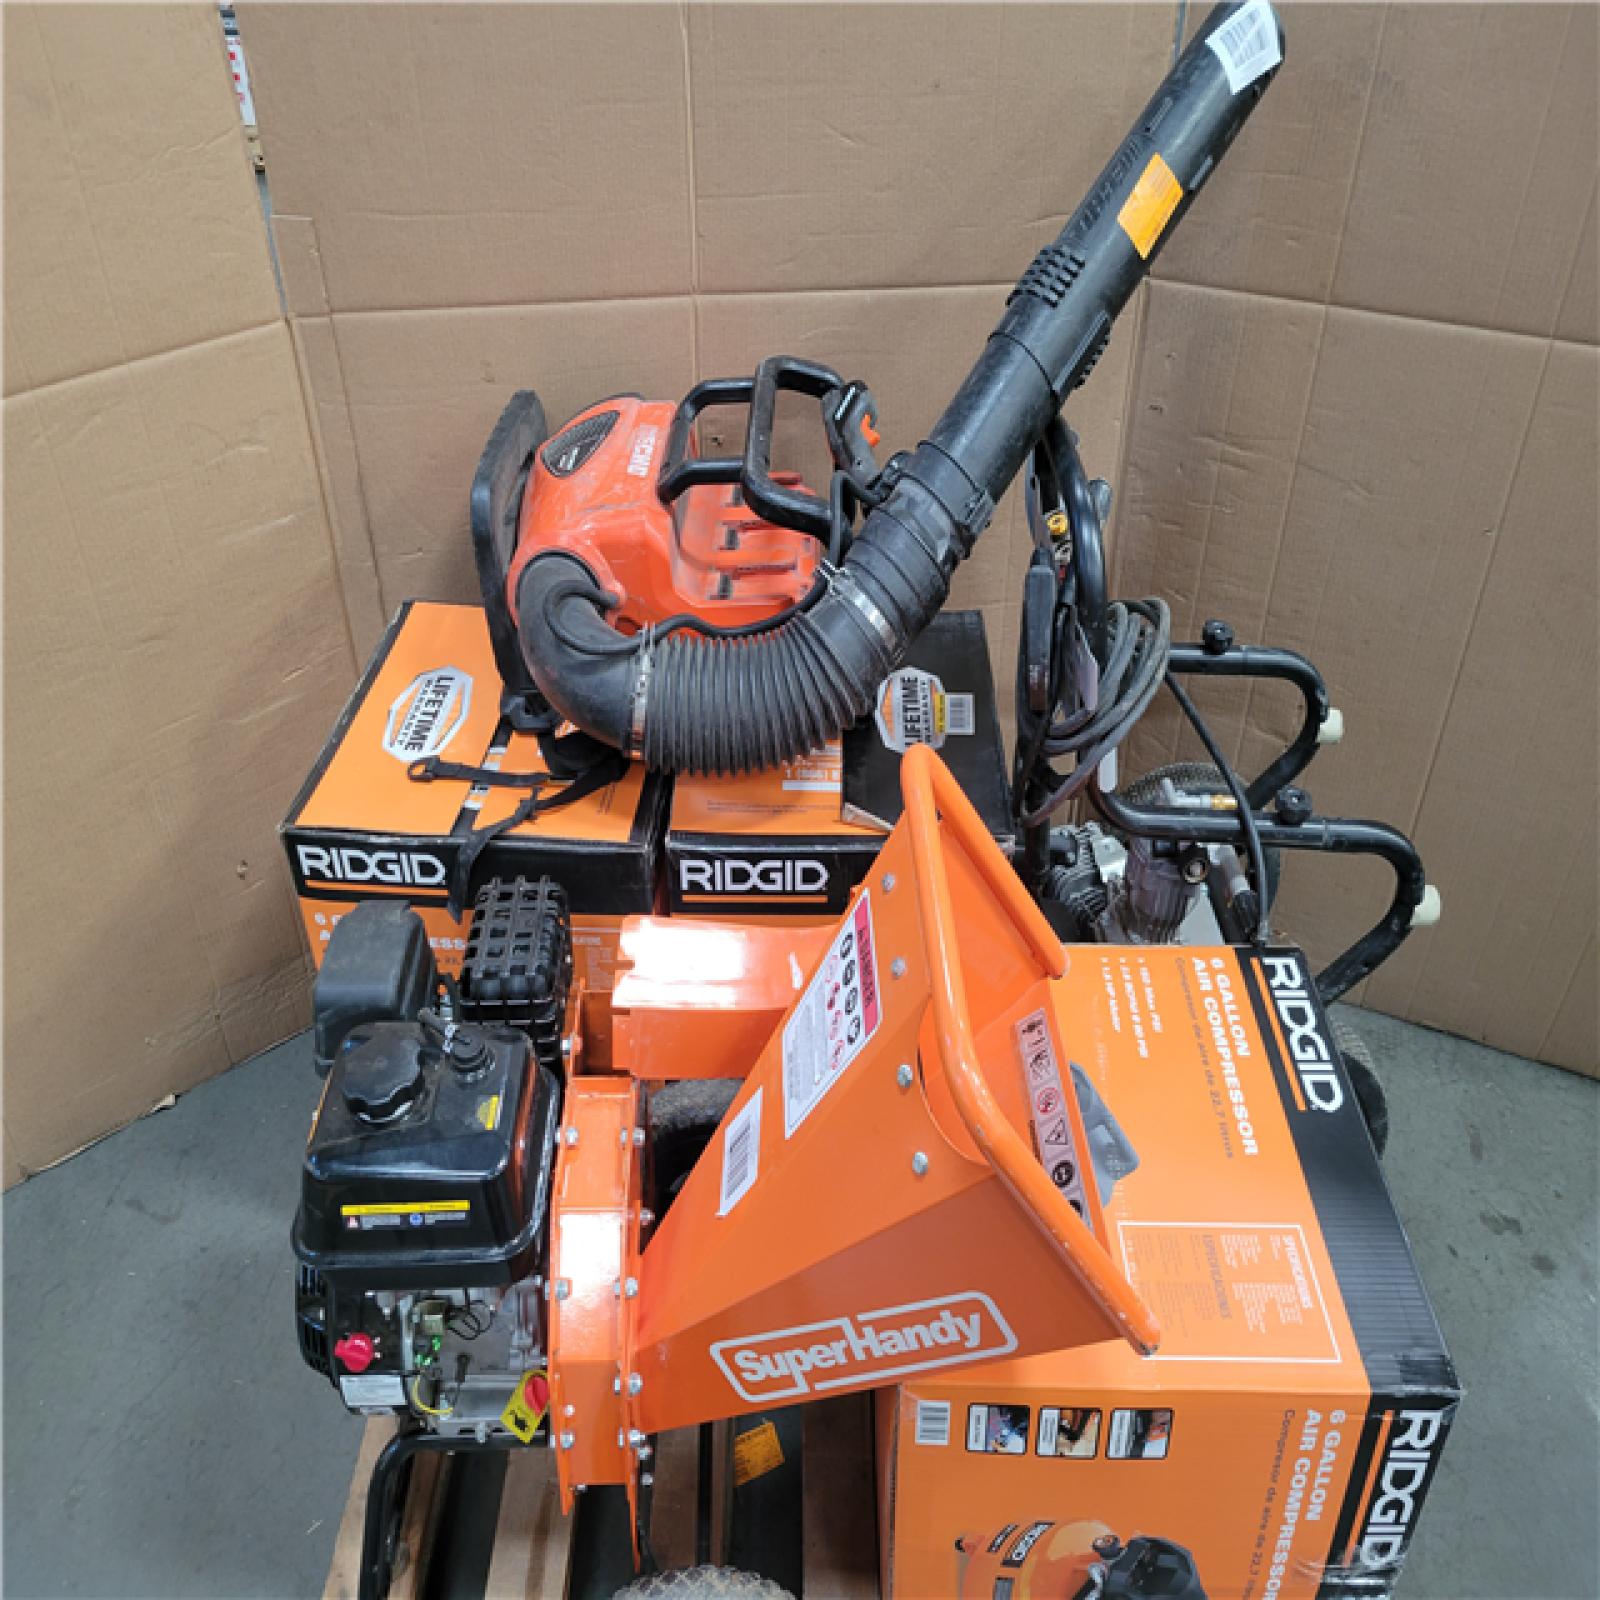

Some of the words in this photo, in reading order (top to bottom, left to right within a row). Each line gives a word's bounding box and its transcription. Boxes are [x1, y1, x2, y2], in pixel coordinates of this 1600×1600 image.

[404, 675, 455, 752] LIFETIME
[296, 844, 446, 885] RIDGID
[679, 859, 830, 892] RIDGID
[1215, 974, 1250, 1056] GALLON
[1262, 957, 1344, 1112] RIDGID
[1203, 997, 1258, 1155] COMPRESSOR
[734, 1310, 981, 1392] SuperHandy
[1299, 1410, 1322, 1450] AIR
[1329, 1410, 1346, 1423] 6
[1305, 1430, 1341, 1520] GALLON
[1360, 1410, 1443, 1569] RIDGID
[1262, 1457, 1311, 1600] COMPRESSOR
